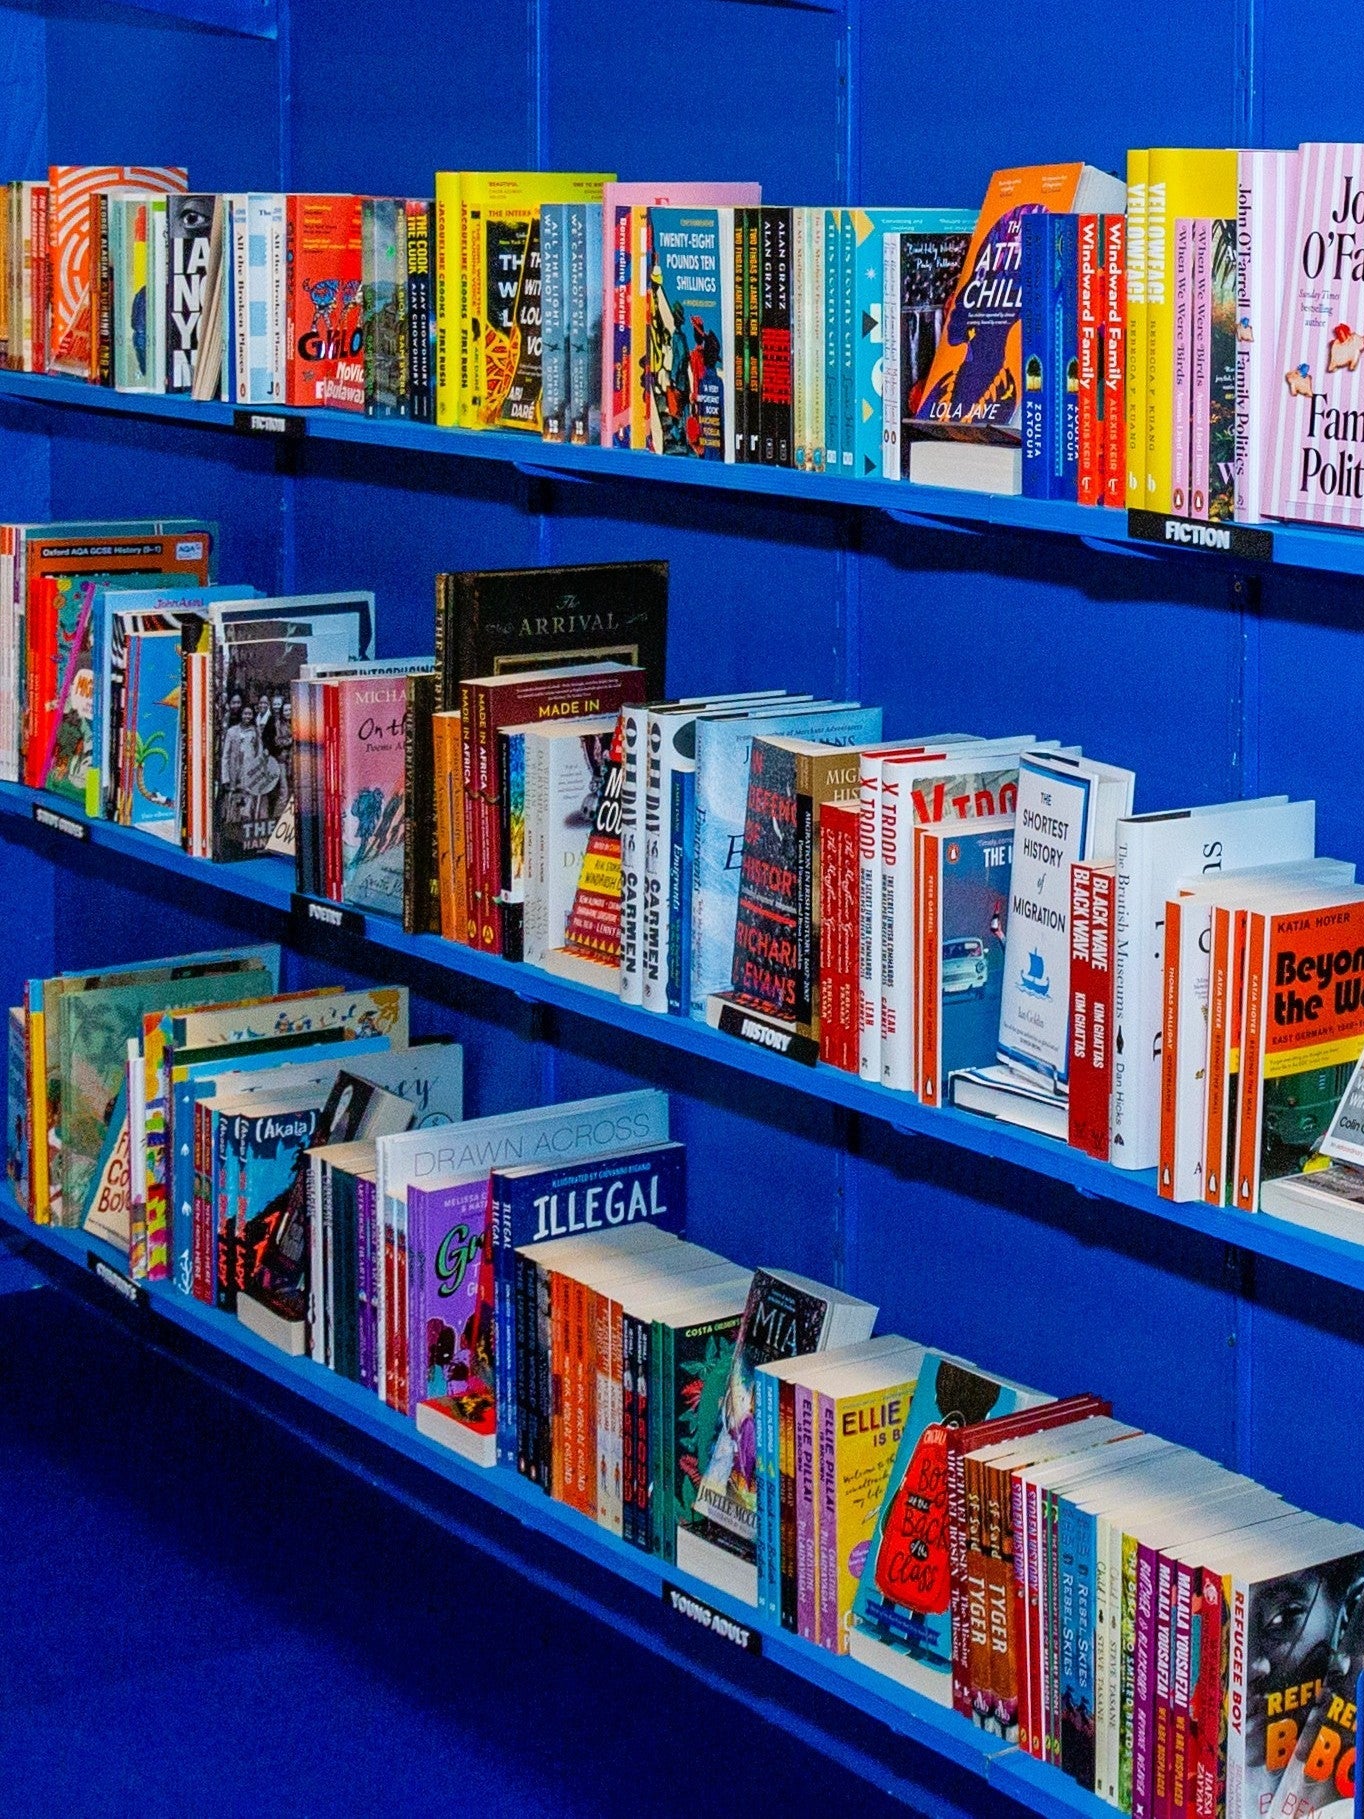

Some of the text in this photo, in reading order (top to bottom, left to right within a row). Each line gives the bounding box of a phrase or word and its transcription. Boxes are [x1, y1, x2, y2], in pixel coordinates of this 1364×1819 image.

[1239, 184, 1252, 225] John
[416, 215, 428, 239] THE
[660, 232, 715, 249] TWENTY-EIGHT
[667, 255, 715, 270] POUNDS TEN
[1177, 226, 1188, 278] When
[439, 272, 447, 318] CROOKS
[676, 275, 716, 292] SHILLINGS
[1081, 223, 1095, 390] Windward Family
[1176, 309, 1186, 343] Were
[439, 357, 447, 387] RUSH
[930, 402, 1000, 420] LOLA JAYE
[1026, 400, 1034, 458] KATOUH
[1034, 403, 1042, 457] ZOULFA
[114, 546, 142, 555] History
[1166, 521, 1230, 549] FICTION
[519, 613, 619, 637] ARRIVAL
[539, 700, 599, 717] MADE IN
[1040, 792, 1052, 806] THE
[882, 782, 898, 865] X TROOP
[1023, 810, 1068, 840] SHORTEST
[1024, 840, 1063, 867] HISTORY
[648, 878, 661, 980] CARMEN
[1013, 896, 1066, 932] MIGRATION
[1091, 875, 1108, 972] BLACK WAVE
[1278, 912, 1350, 933] KATJA HOYER
[1117, 939, 1128, 1019] Museums
[1274, 991, 1328, 1027] the
[742, 1019, 791, 1051] HISTORY
[1092, 1002, 1104, 1068] KIM GHATTAS
[1115, 1062, 1125, 1125] Dan Hicks
[414, 1113, 650, 1177] DRAWN ACROSS
[533, 1175, 667, 1241] ILLEGAL
[823, 1407, 834, 1448] ELLIE
[670, 1590, 749, 1647] YOUNG ADULT
[989, 1583, 1007, 1653] TYGER
[1077, 1582, 1089, 1688] REBEL SKIES
[1176, 1572, 1191, 1708] MALALA YOUSAFZAI
[1231, 1591, 1244, 1735] REFUGEE BOY
